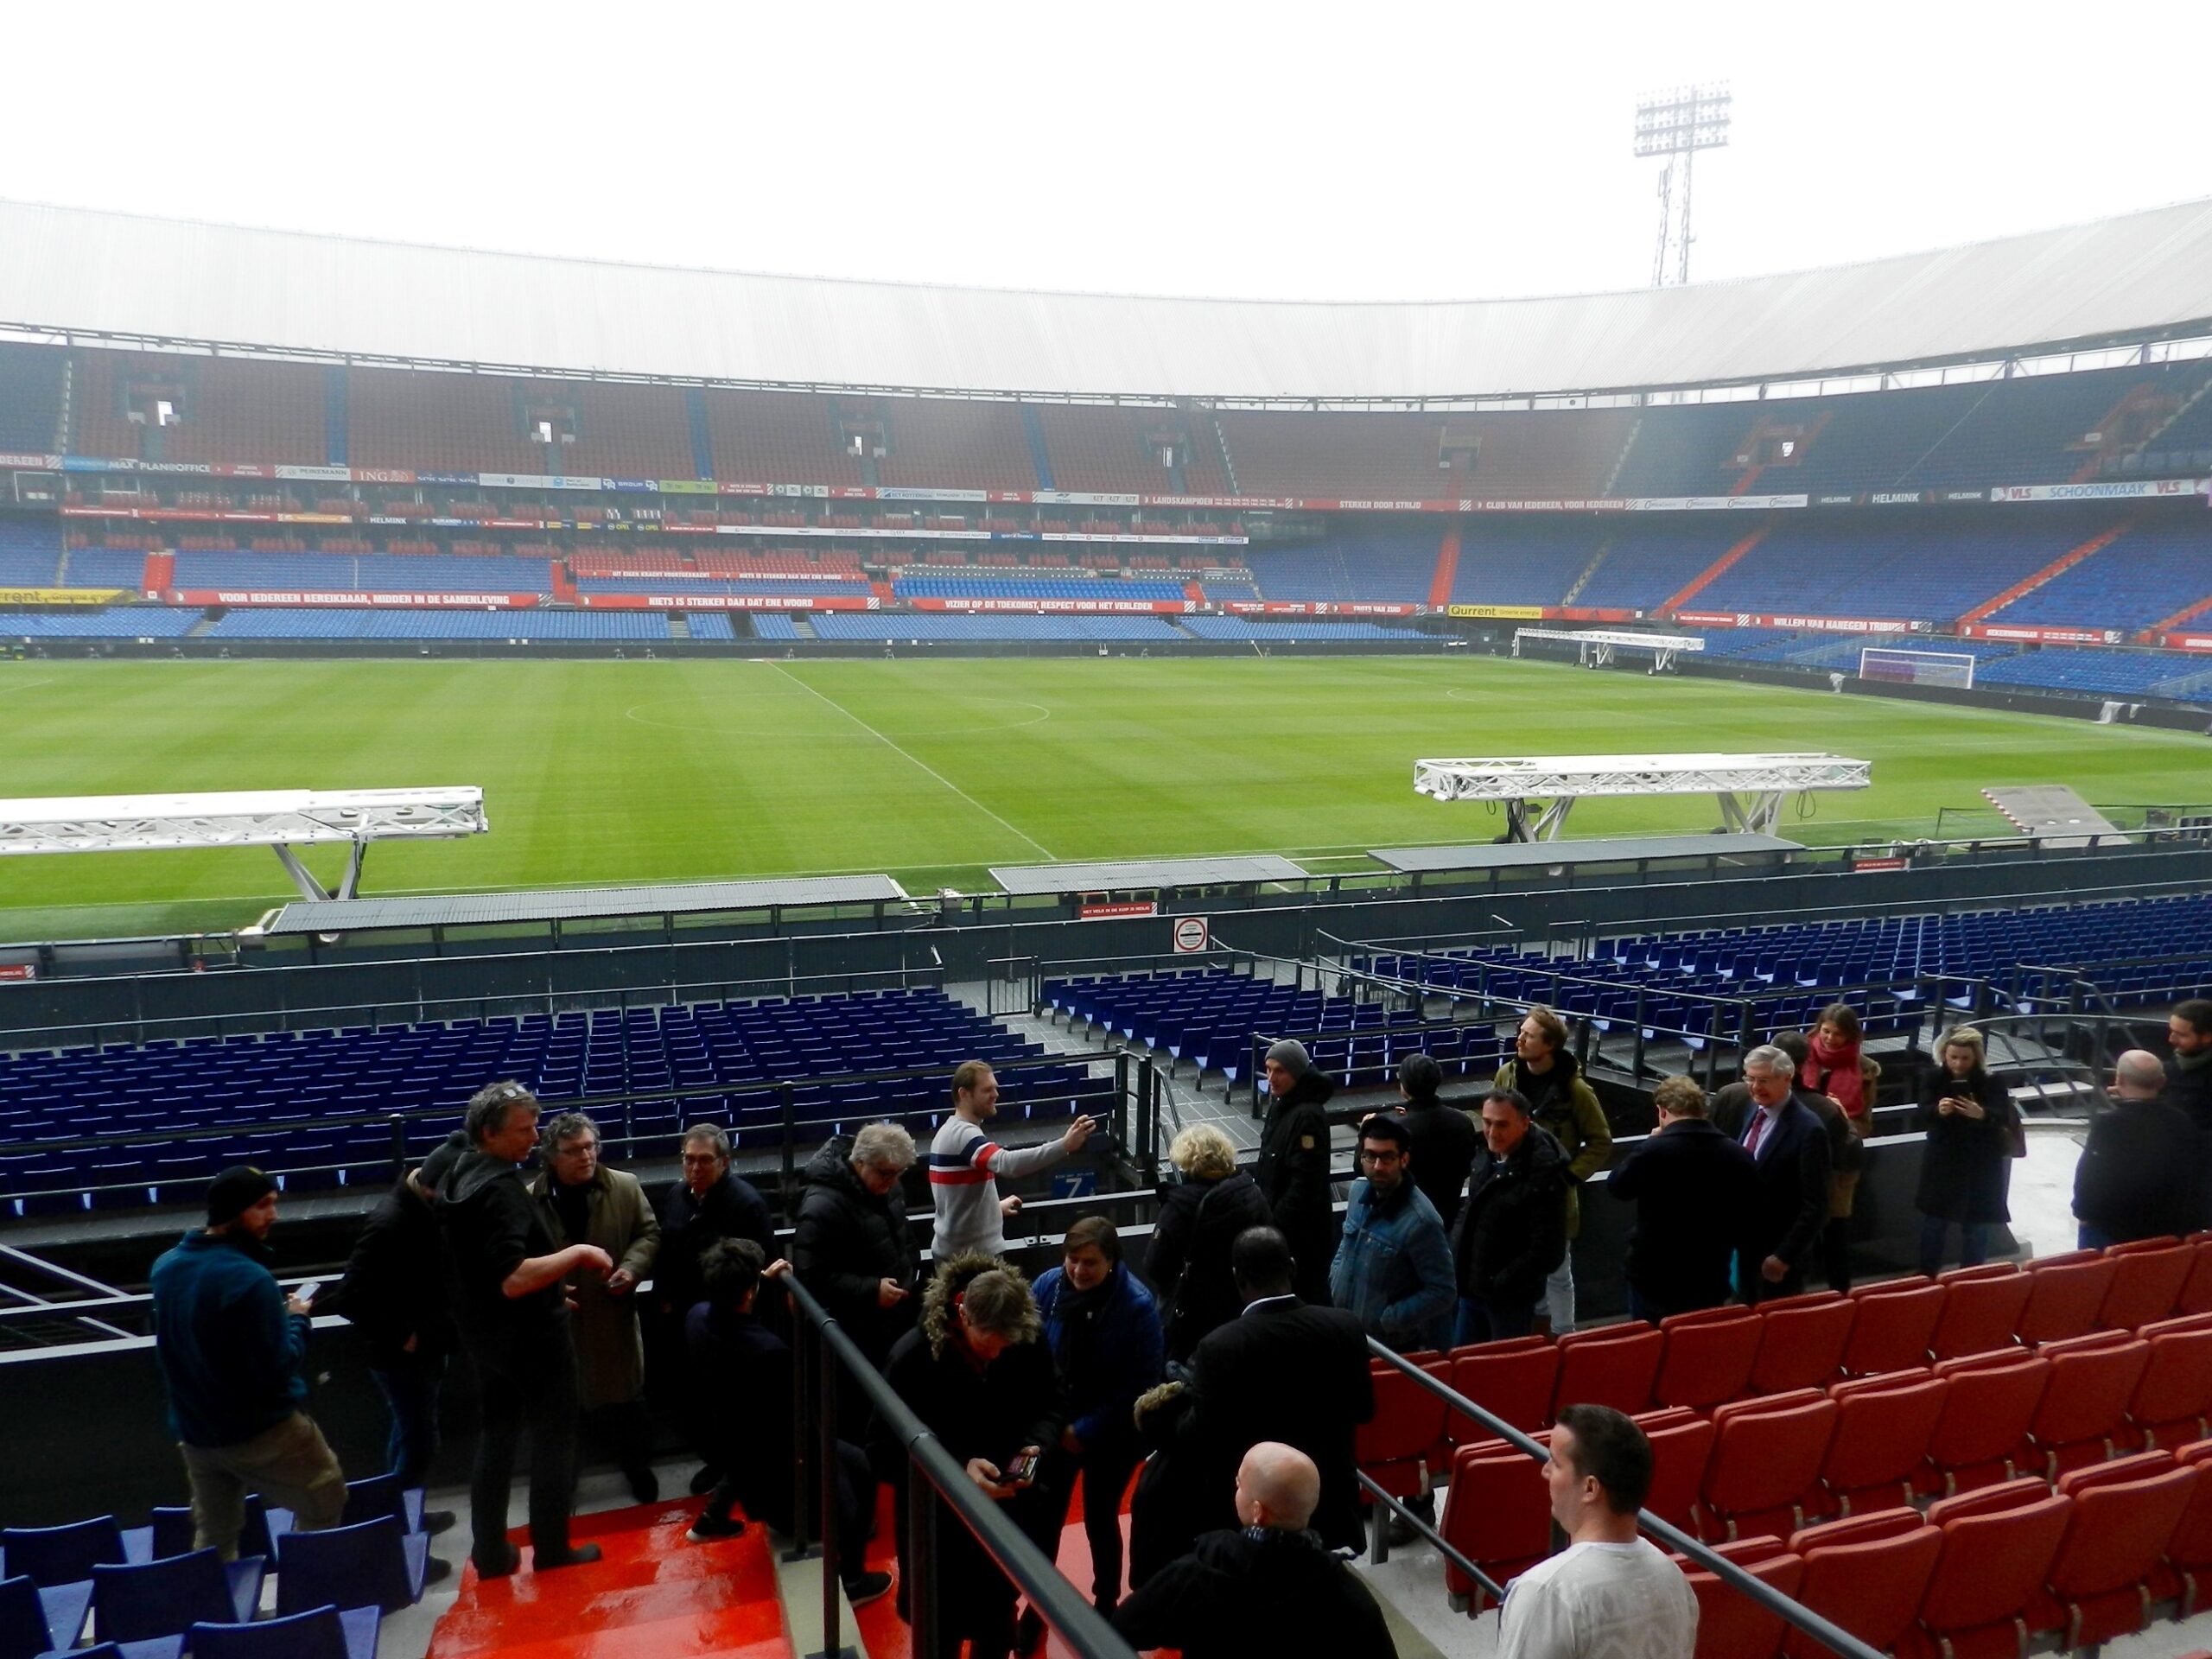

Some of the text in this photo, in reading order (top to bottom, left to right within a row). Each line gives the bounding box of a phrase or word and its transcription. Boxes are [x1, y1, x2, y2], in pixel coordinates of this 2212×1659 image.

[359, 472, 388, 482] ING
[2050, 482, 2147, 498] SCHOONMAAK
[2157, 481, 2180, 494] VLS
[1872, 493, 1920, 503] HELMINK
[2011, 488, 2032, 499] VLS
[1153, 496, 1214, 505] LANDSKAMPIOEN
[1339, 500, 1372, 509] STERKER
[1486, 501, 1506, 510] CLUB
[1507, 501, 1522, 510] VAN
[1565, 500, 1585, 510] VOOR
[1586, 500, 1624, 509] IEDEREEN
[0, 592, 41, 602] rent
[219, 593, 248, 602] VOOR
[251, 594, 301, 603] IEDEREEN
[372, 594, 412, 604] MIDDEN
[414, 594, 425, 604] IN
[427, 594, 441, 604] DE
[442, 594, 510, 604] SAMENLEVING
[648, 597, 674, 606] NIETS
[687, 598, 725, 607] STERKER
[727, 598, 746, 607] DAN
[747, 598, 764, 607] DAT
[945, 600, 969, 608] VIZIER
[1040, 601, 1075, 609] RESPECT
[1098, 601, 1114, 610] HET
[1115, 601, 1153, 610] VERLEDEN
[1452, 606, 1497, 616] Qurrent
[1774, 617, 1805, 627] WILLEM
[1807, 619, 1824, 629] VAN
[1826, 620, 1867, 631] HANEGEM
[1065, 1177, 1082, 1198] 7
